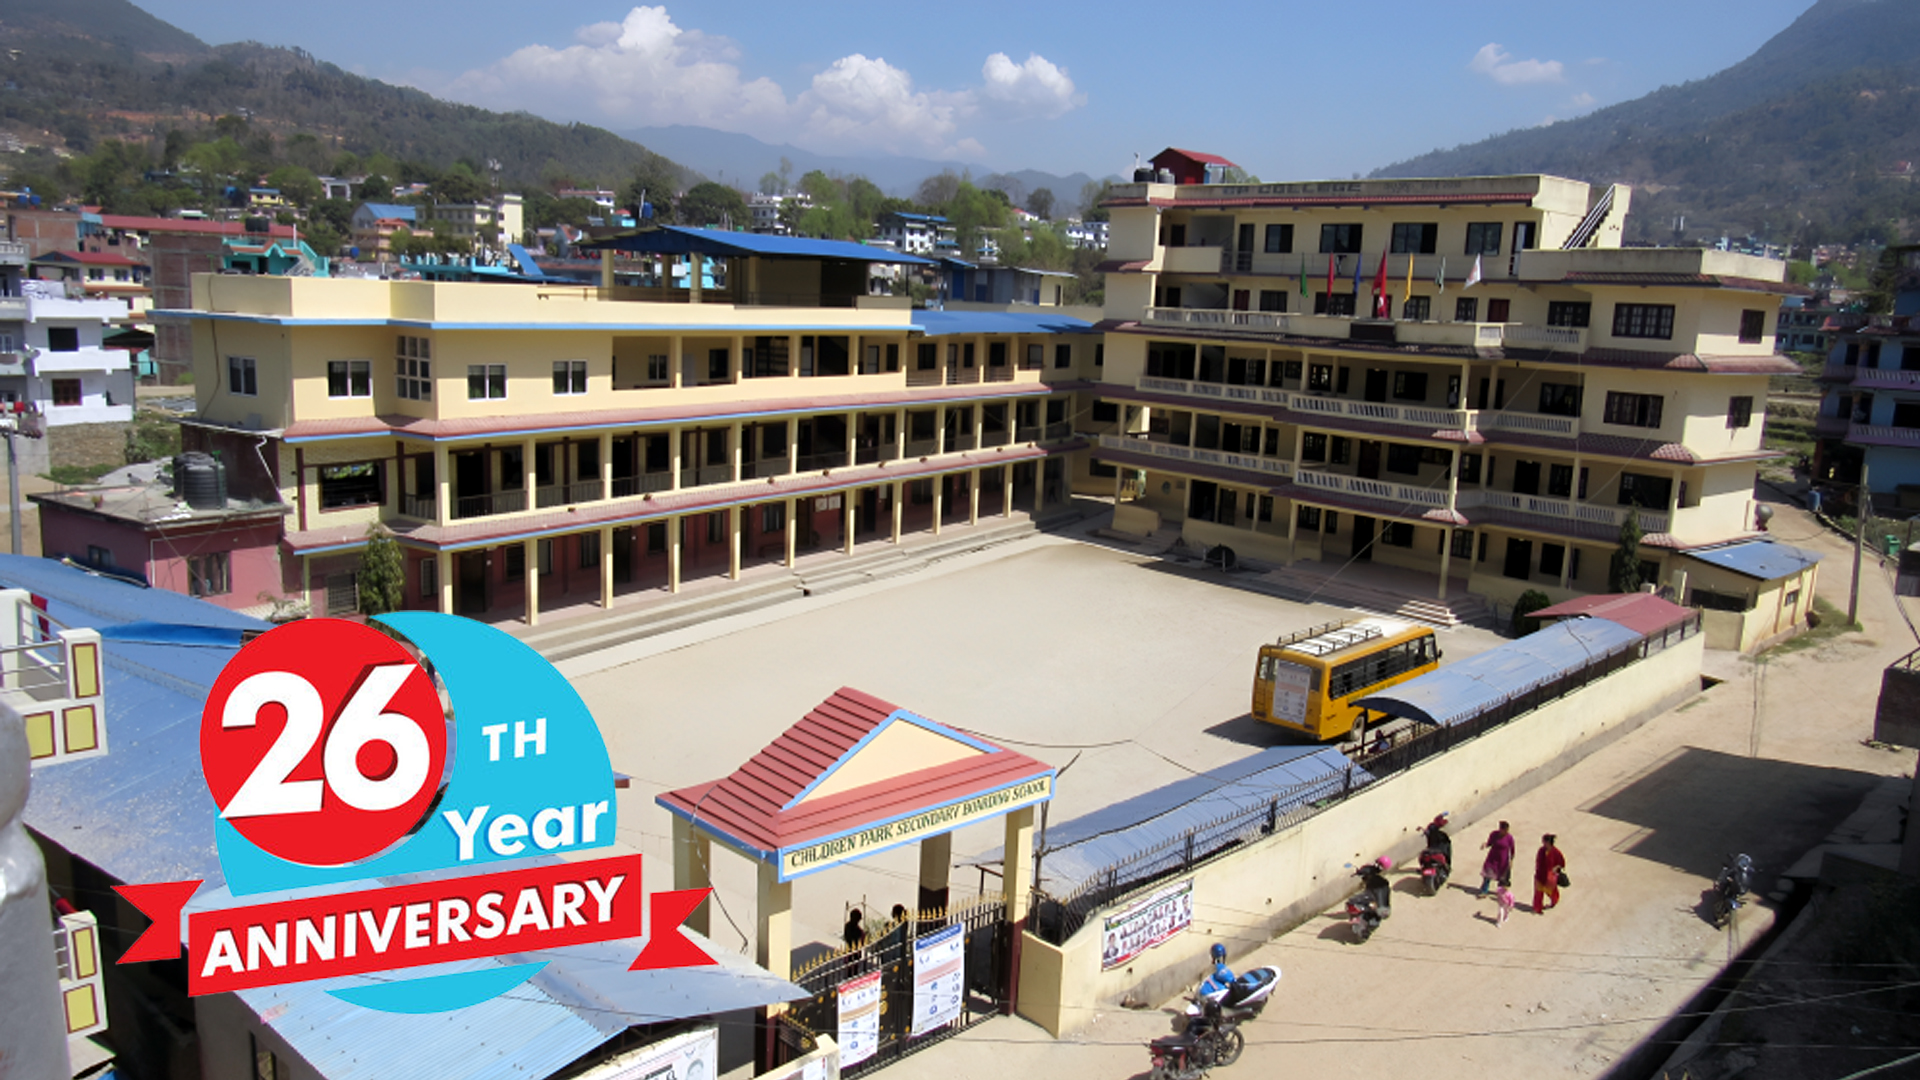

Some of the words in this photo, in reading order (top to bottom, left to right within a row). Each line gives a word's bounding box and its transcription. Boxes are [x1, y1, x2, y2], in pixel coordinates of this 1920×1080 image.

[1258, 183, 1361, 194] COLLEGE
[791, 836, 857, 867] CHILDREN
[860, 824, 895, 847] PARK
[896, 805, 961, 837] SECONDARY
[962, 789, 1011, 816] BOARDING
[1012, 780, 1047, 801] SCHOOL
